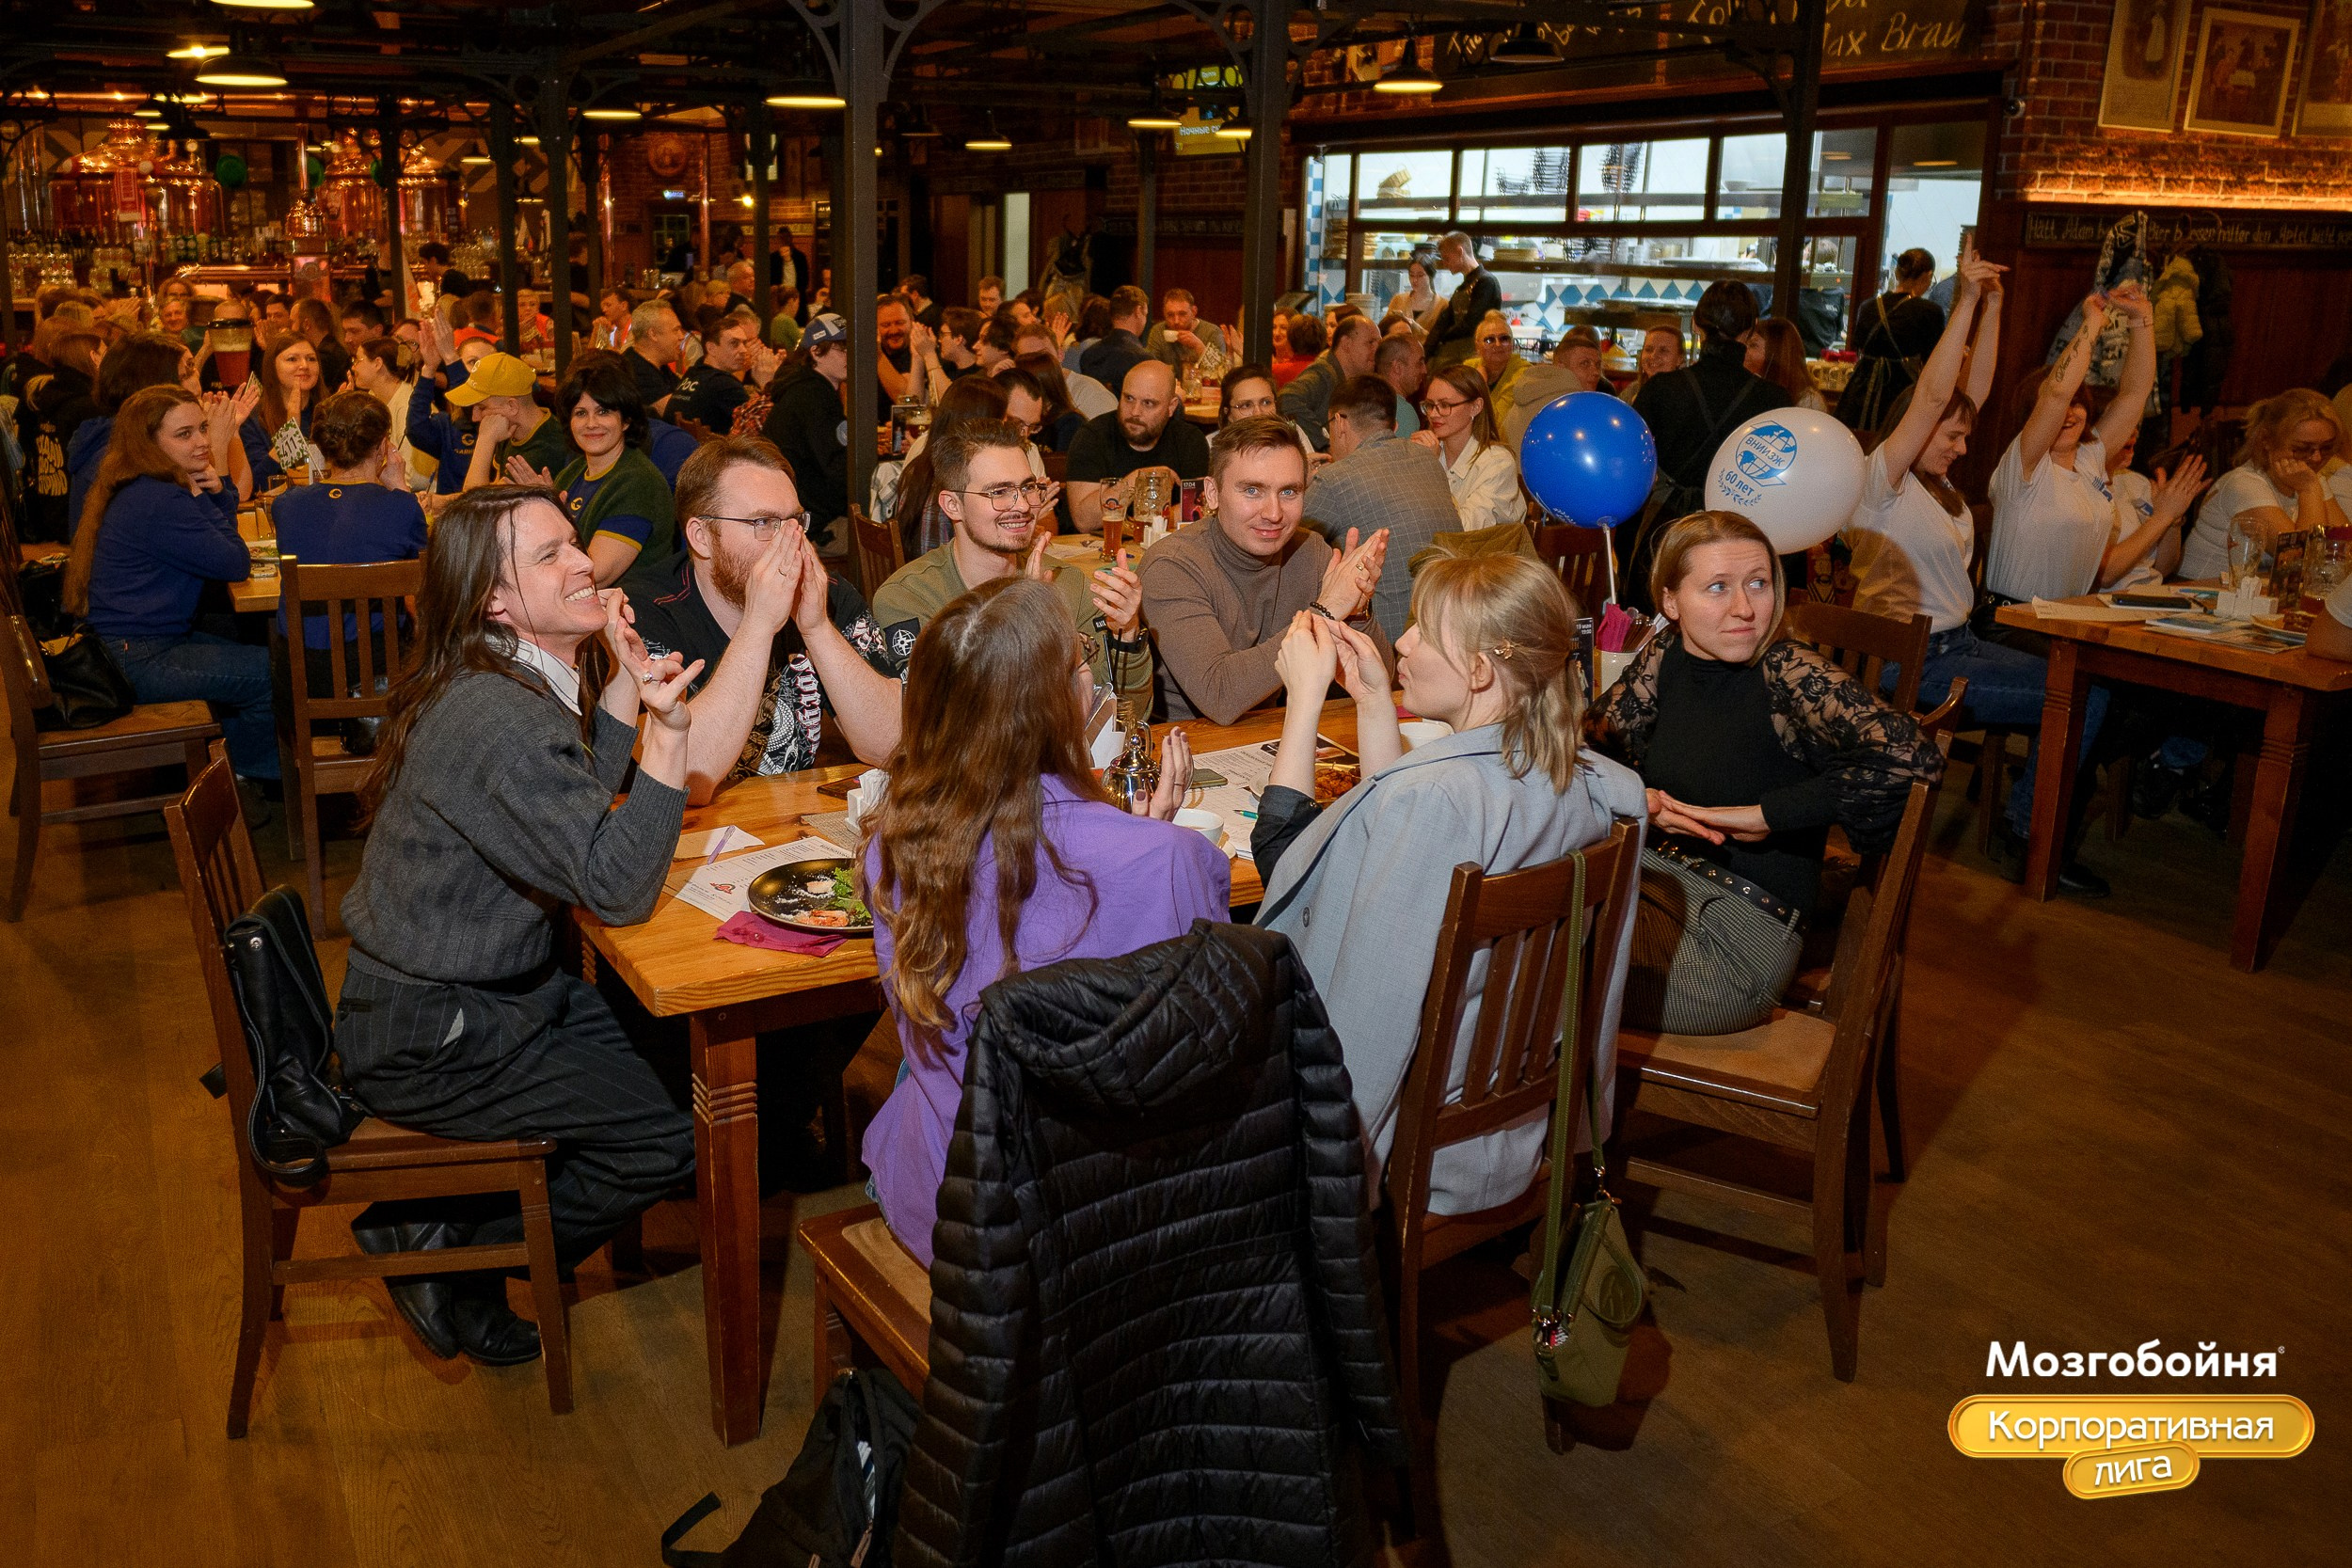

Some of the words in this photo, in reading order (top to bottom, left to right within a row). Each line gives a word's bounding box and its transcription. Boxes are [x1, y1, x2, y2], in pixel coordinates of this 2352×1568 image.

[1882, 11, 1965, 52] Brau
[1745, 436, 1786, 467] ВНИИЗЖ
[1725, 470, 1738, 484] 60
[1736, 480, 1755, 496] лет
